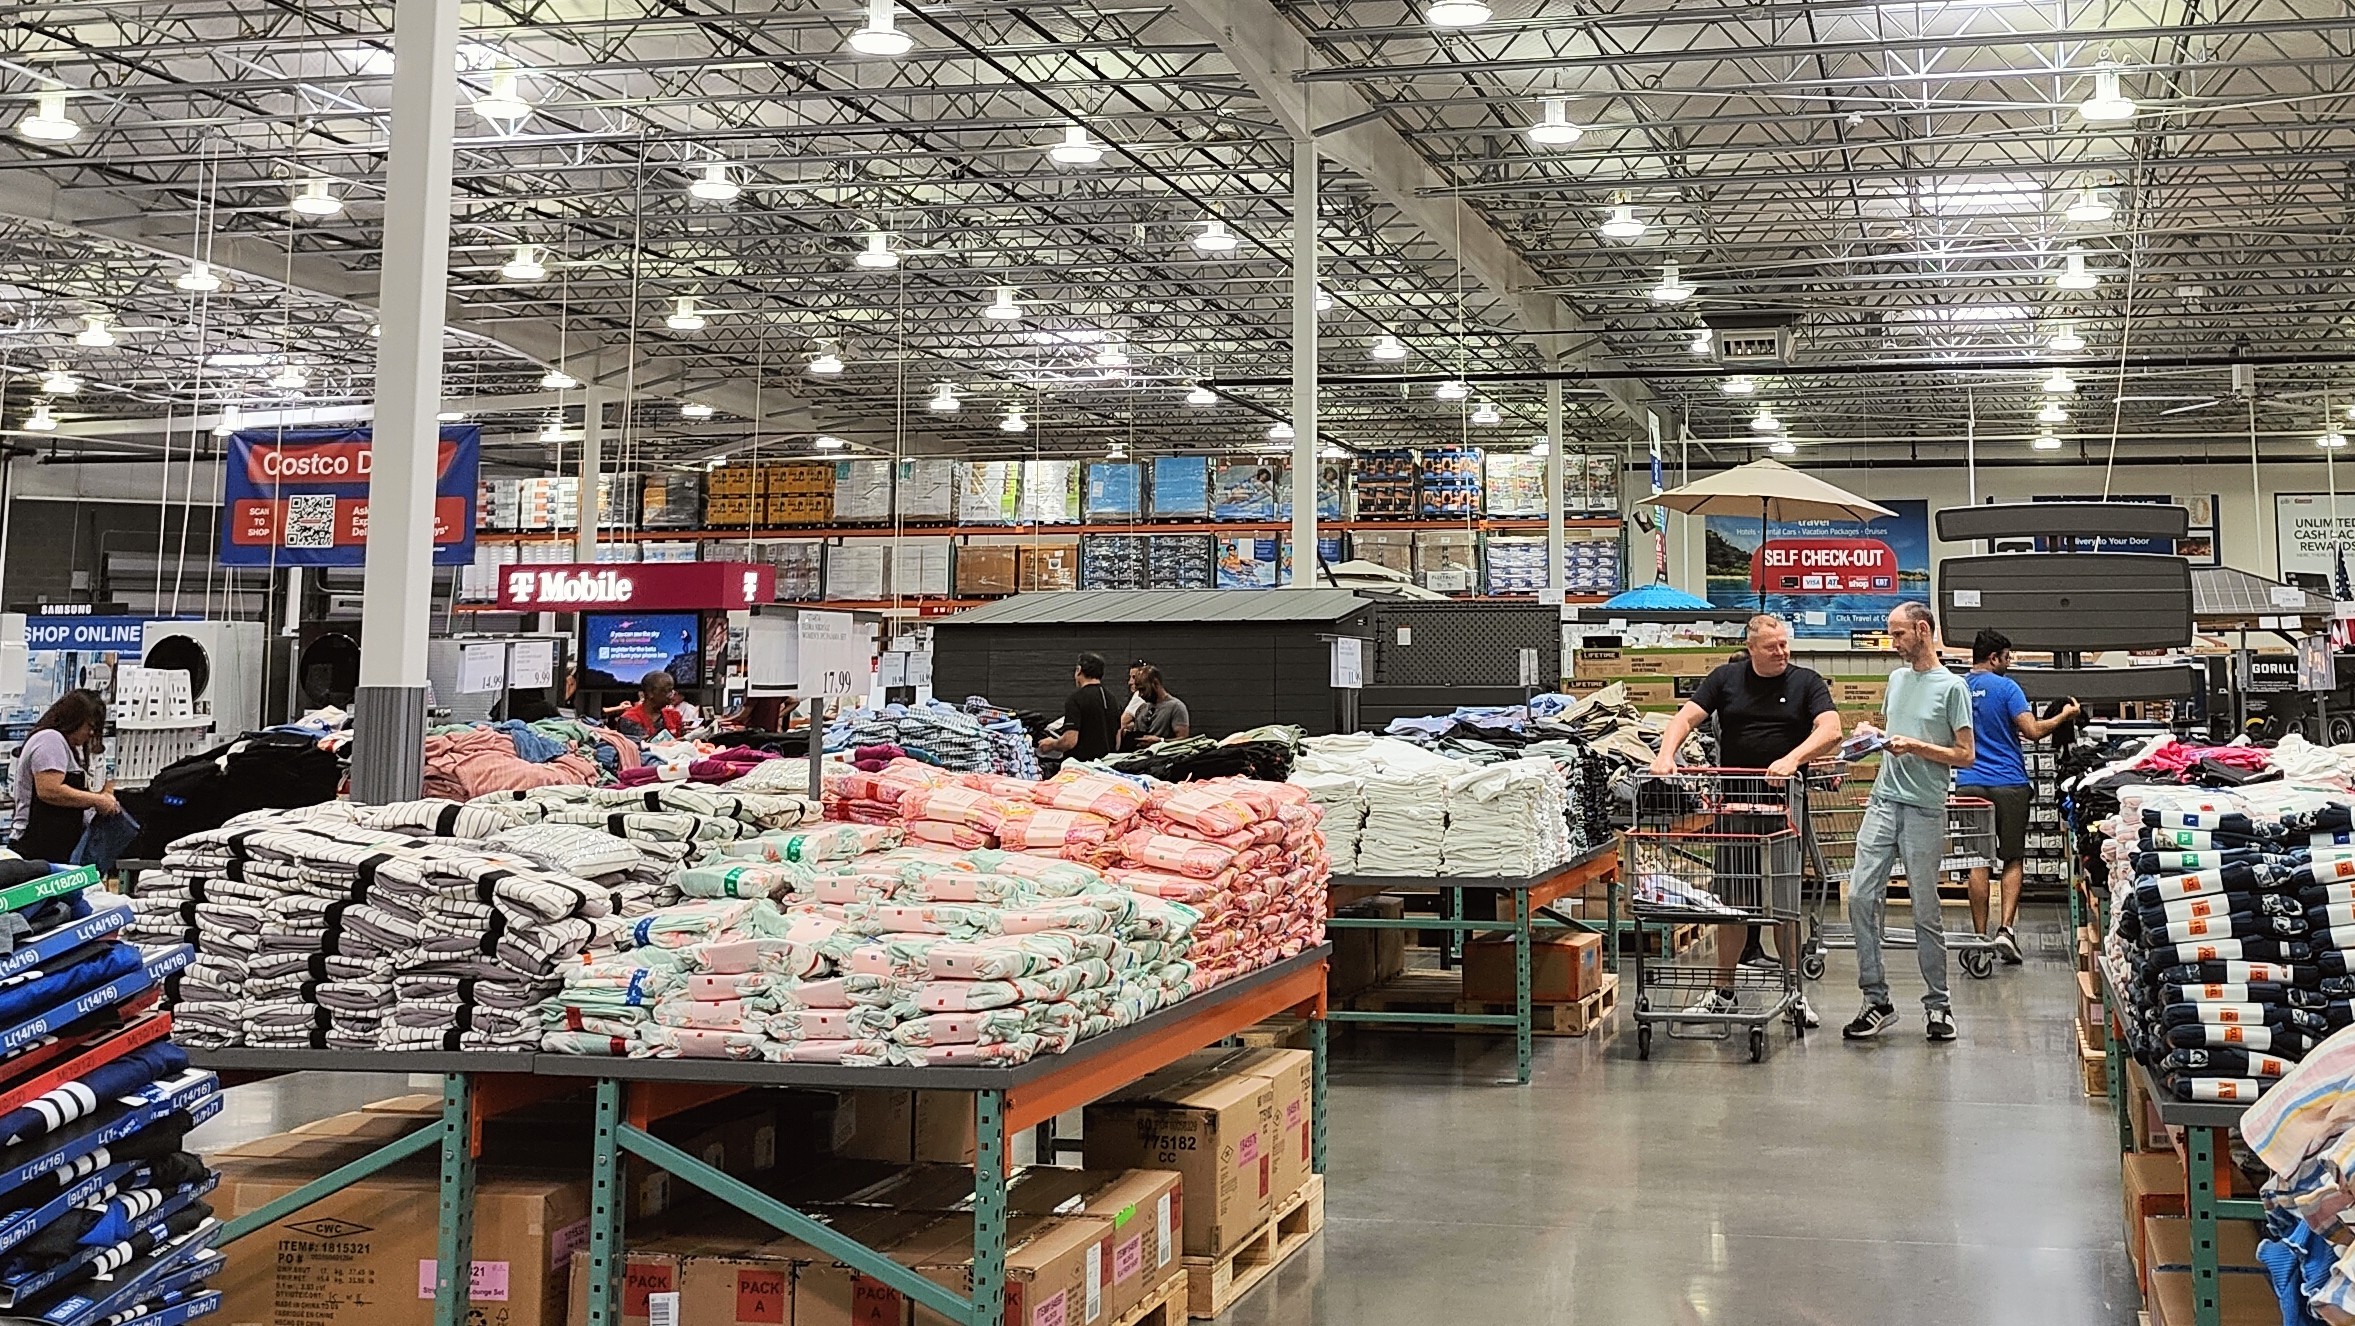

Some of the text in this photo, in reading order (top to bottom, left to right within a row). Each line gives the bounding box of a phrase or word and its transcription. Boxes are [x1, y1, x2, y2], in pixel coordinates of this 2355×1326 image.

[263, 451, 373, 476] Costco D
[249, 507, 270, 516] SCAN
[254, 517, 265, 526] TO
[2295, 518, 2355, 528] UNLIMTED
[248, 528, 270, 537] SHOP
[1736, 528, 1757, 536] Hotels
[1766, 528, 1782, 536] ental
[1802, 528, 1829, 536] Vacation
[1830, 528, 1859, 537] Packages
[1864, 528, 1888, 536] Cruises
[2294, 530, 2327, 540] CASH
[2108, 537, 2128, 546] Your
[2129, 537, 2150, 546] Door
[2300, 542, 2355, 552] REWADS
[1764, 550, 1884, 567] SELF CHECK-OUT
[537, 571, 633, 603] Mobile
[41, 604, 92, 615] SAMSUNG
[1852, 614, 1871, 622] Travel
[74, 626, 141, 642] ONLINE
[2252, 663, 2299, 674] GORILL
[482, 675, 502, 689] 14.99
[535, 671, 550, 684] 9.99
[823, 671, 852, 694] 17.99
[35, 871, 88, 897] XL(18/20)
[77, 912, 125, 940] L(14/16)
[0, 949, 40, 977] (14/16)
[149, 952, 187, 979] L(14/16)
[77, 986, 118, 1013] L(14/16)
[4, 1019, 47, 1048] L(14/16)
[173, 1083, 211, 1108] L(14/16)
[1143, 1136, 1197, 1150] 775182
[1158, 1153, 1177, 1163] CC
[21, 1152, 65, 1181] L(14/16)
[68, 1176, 102, 1207] L(14/16)
[316, 1224, 342, 1233] CWC
[278, 1241, 370, 1254] ITEM#: 1815321
[278, 1253, 294, 1263] PO
[629, 1275, 668, 1290] PACK
[741, 1281, 780, 1296] PACK
[471, 1289, 492, 1297] ounge
[857, 1287, 900, 1301] PACK
[187, 1298, 217, 1318] L(14/16)
[754, 1301, 765, 1313] A
[871, 1306, 882, 1319] A
